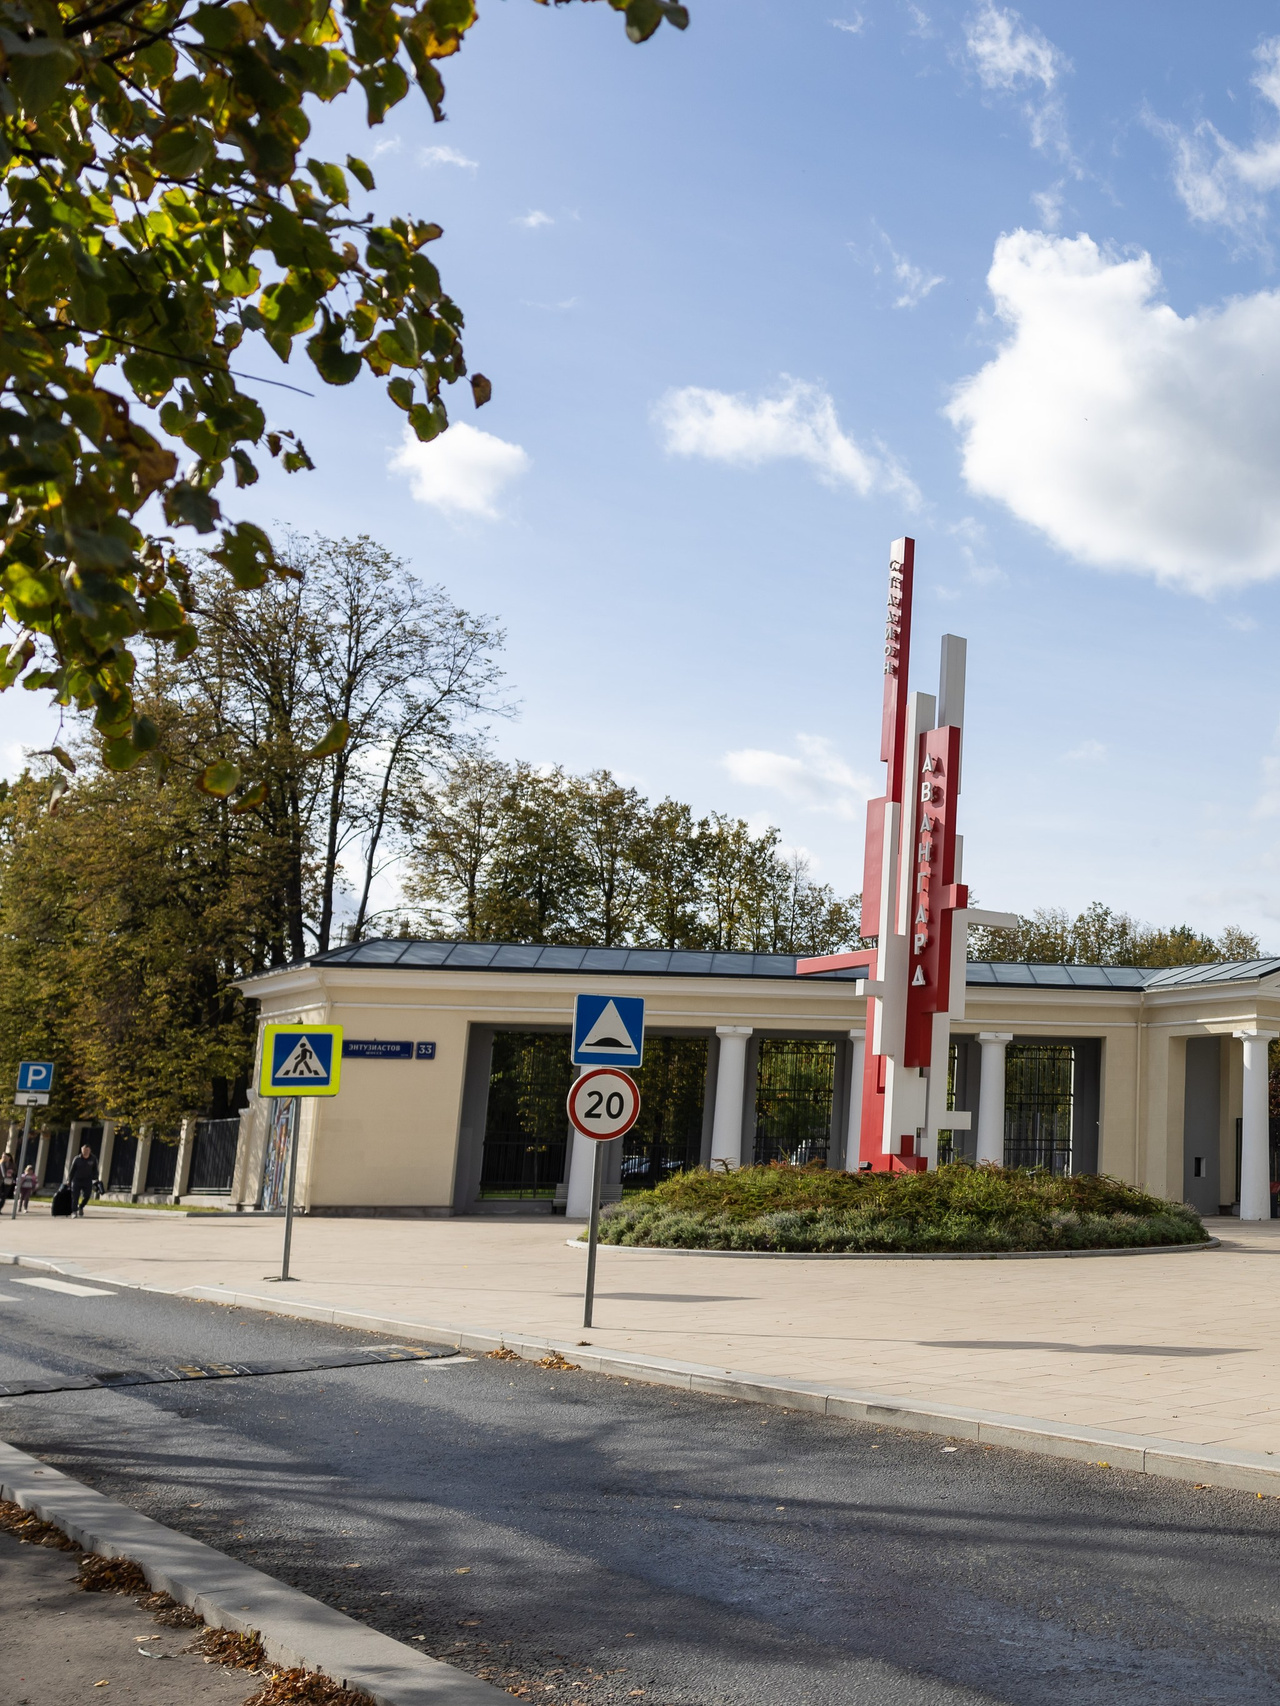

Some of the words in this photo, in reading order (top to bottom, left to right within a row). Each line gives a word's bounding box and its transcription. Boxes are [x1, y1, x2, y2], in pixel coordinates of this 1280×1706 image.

[883, 560, 901, 675] СТАДИОН
[911, 752, 934, 986] АВАНГАРД
[348, 1043, 401, 1051] ЭНТУЗИАСТОВ
[418, 1044, 433, 1054] 33
[26, 1065, 47, 1088] P
[583, 1090, 625, 1120] 20
